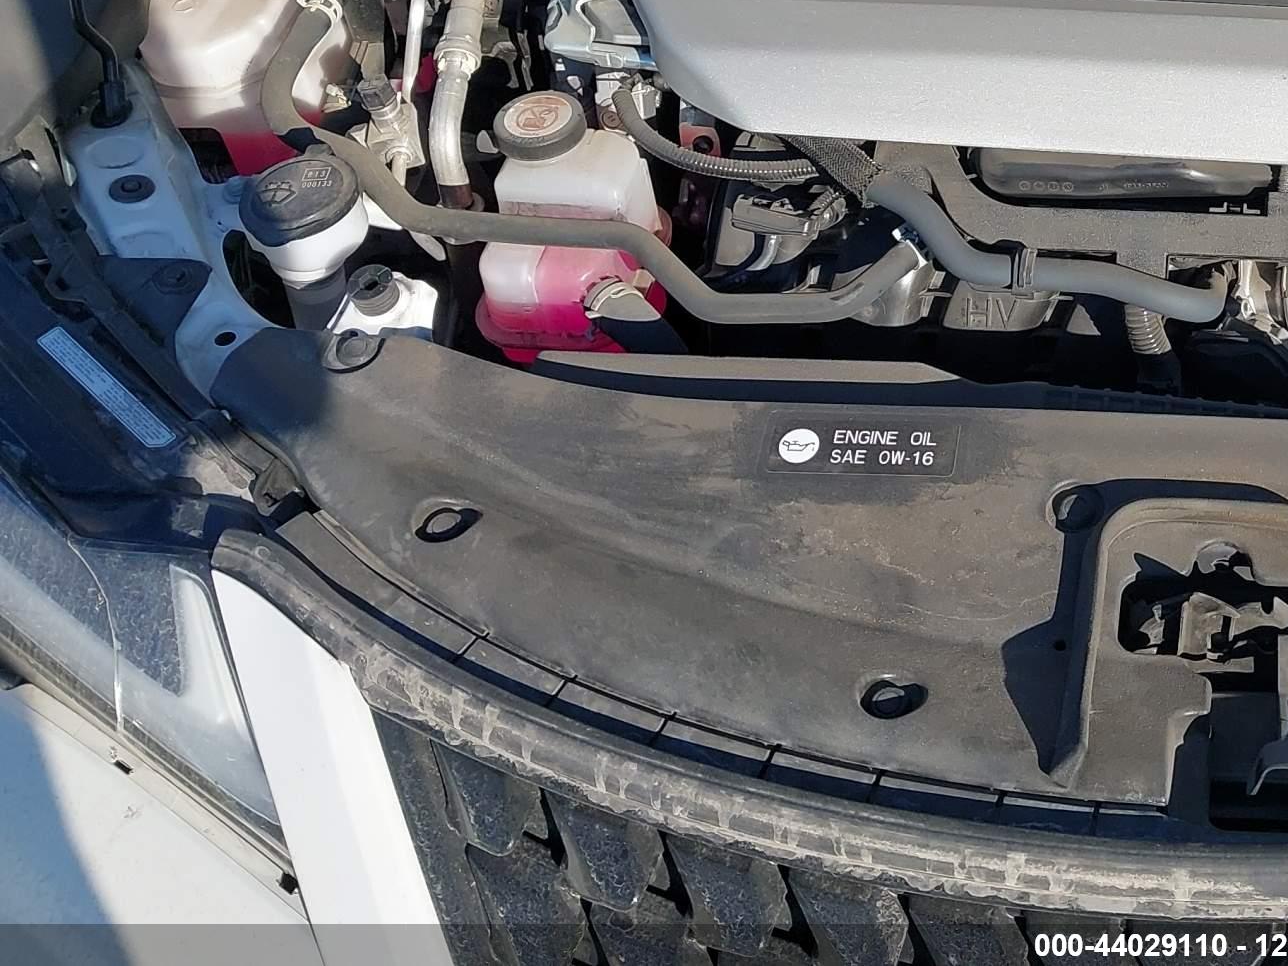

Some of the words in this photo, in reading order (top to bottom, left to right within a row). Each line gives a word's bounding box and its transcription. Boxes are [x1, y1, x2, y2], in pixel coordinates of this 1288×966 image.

[966, 297, 1018, 330] HV
[833, 429, 899, 446] ENGINE
[910, 431, 937, 447] OIL
[830, 449, 867, 465] SAE
[878, 450, 935, 466] 0W-16
